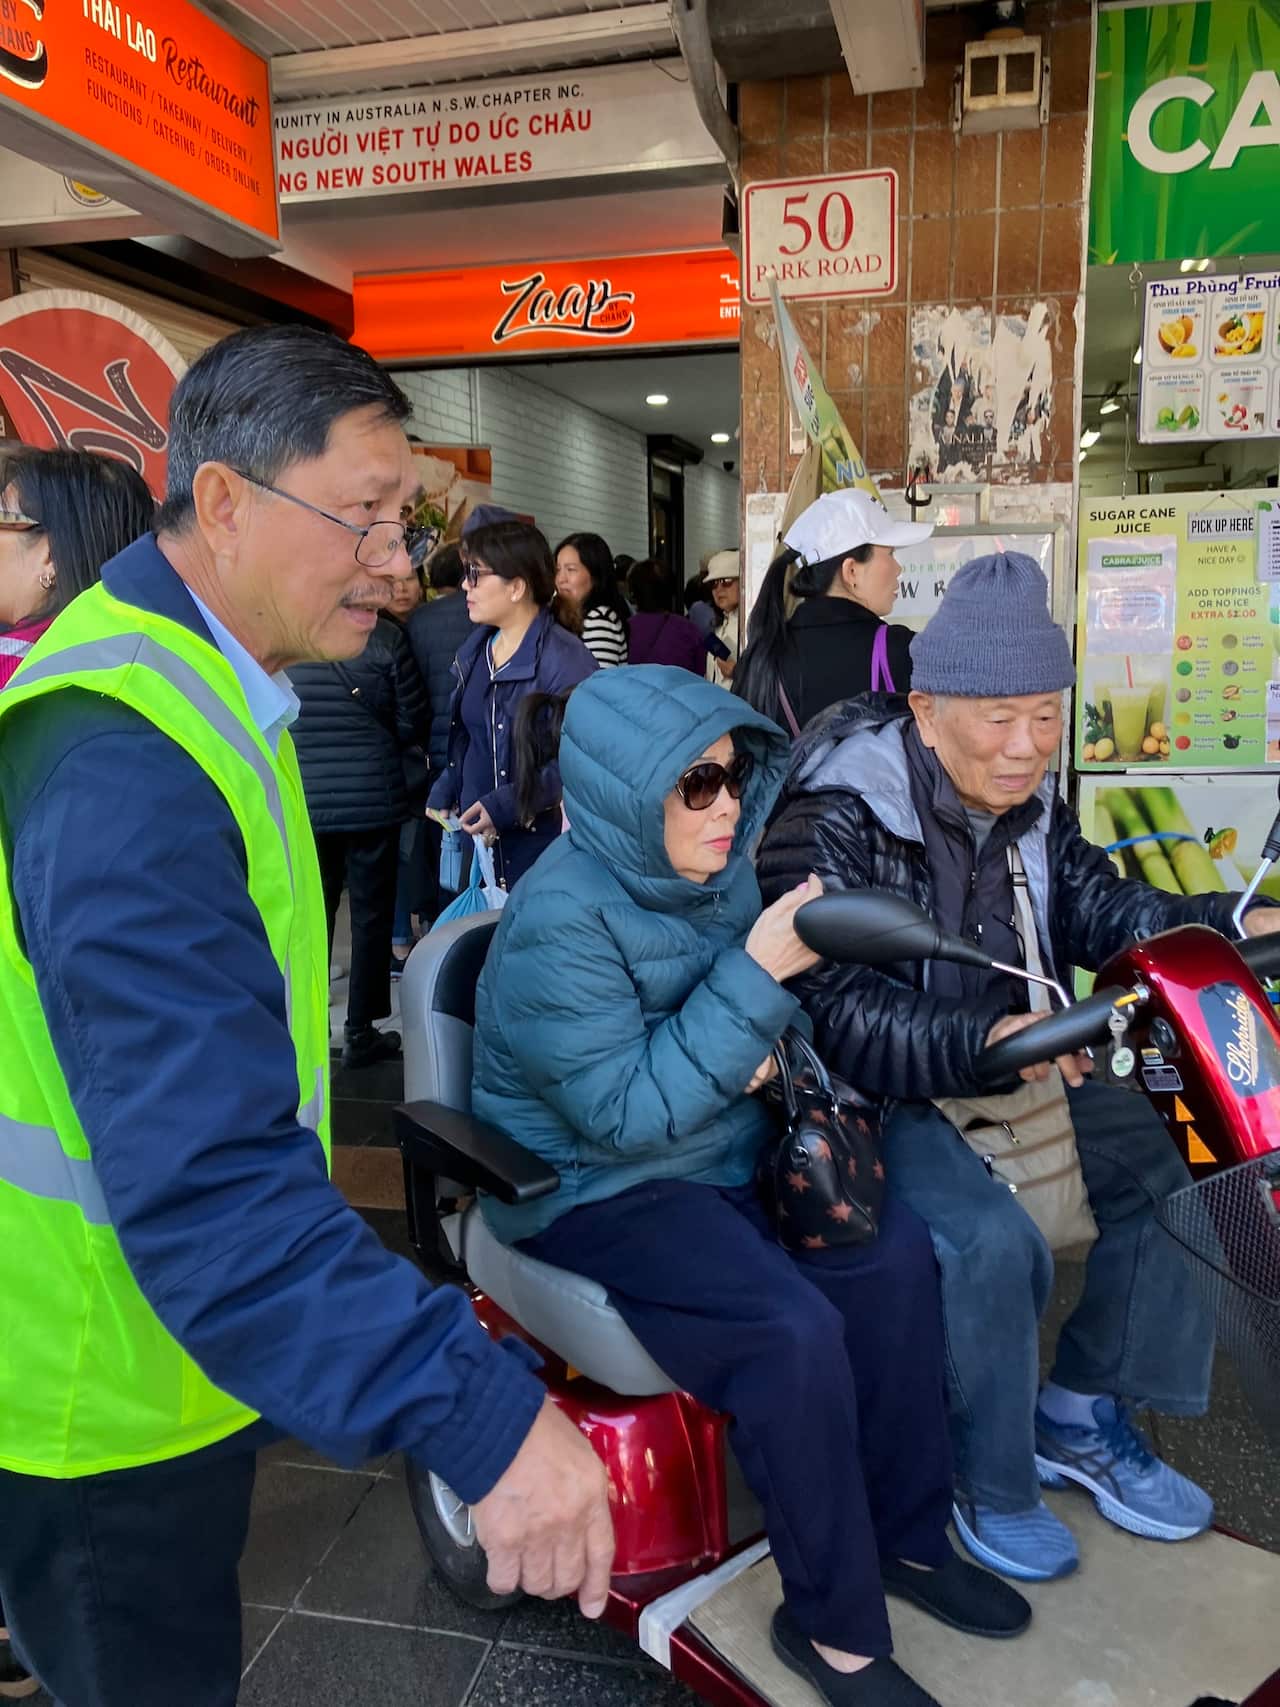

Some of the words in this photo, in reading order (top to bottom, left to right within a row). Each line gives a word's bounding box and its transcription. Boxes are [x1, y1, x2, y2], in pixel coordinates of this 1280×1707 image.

[125, 12, 158, 63] LAO
[85, 47, 148, 101] RESTAURANT
[157, 92, 202, 136] TAKEAWAY
[161, 37, 260, 128] Restaurant
[87, 77, 143, 127] FUNCTIONS
[153, 118, 196, 158] CATERING
[327, 111, 340, 125] IN
[346, 101, 427, 123] AUSTRALIA
[483, 87, 551, 108] CHAPTER
[558, 83, 585, 99] INC.
[280, 126, 349, 161] NGƯỜI
[356, 126, 405, 156] VIỆT
[412, 120, 442, 152] TỰ
[449, 120, 481, 145] DO
[528, 107, 592, 137] CHÂU
[316, 165, 364, 191] NEW
[372, 158, 446, 186] SOUTH
[455, 150, 534, 179] WALES
[777, 190, 856, 257] 50
[755, 259, 810, 284] PARK
[817, 253, 883, 277] ROAD
[1150, 283, 1179, 299] Thu
[1185, 279, 1239, 296] Phùng
[492, 271, 636, 345] Zaap
[1089, 510, 1138, 522] SUGAR
[1140, 507, 1177, 520] CANE
[1113, 523, 1151, 535] JUICE
[1191, 519, 1214, 534] PICK
[1215, 518, 1227, 532] UP
[1229, 517, 1254, 532] HERE
[1197, 556, 1217, 566] NICE
[1218, 555, 1235, 565] DAY
[1206, 545, 1230, 554] HAVE
[1230, 545, 1238, 553] A
[1187, 589, 1209, 598] ADD
[1211, 587, 1262, 597] TOPPINGS
[1198, 600, 1214, 608] OR
[1215, 599, 1231, 608] NO
[1233, 598, 1249, 607] ICE
[1190, 610, 1224, 620] EXTRA
